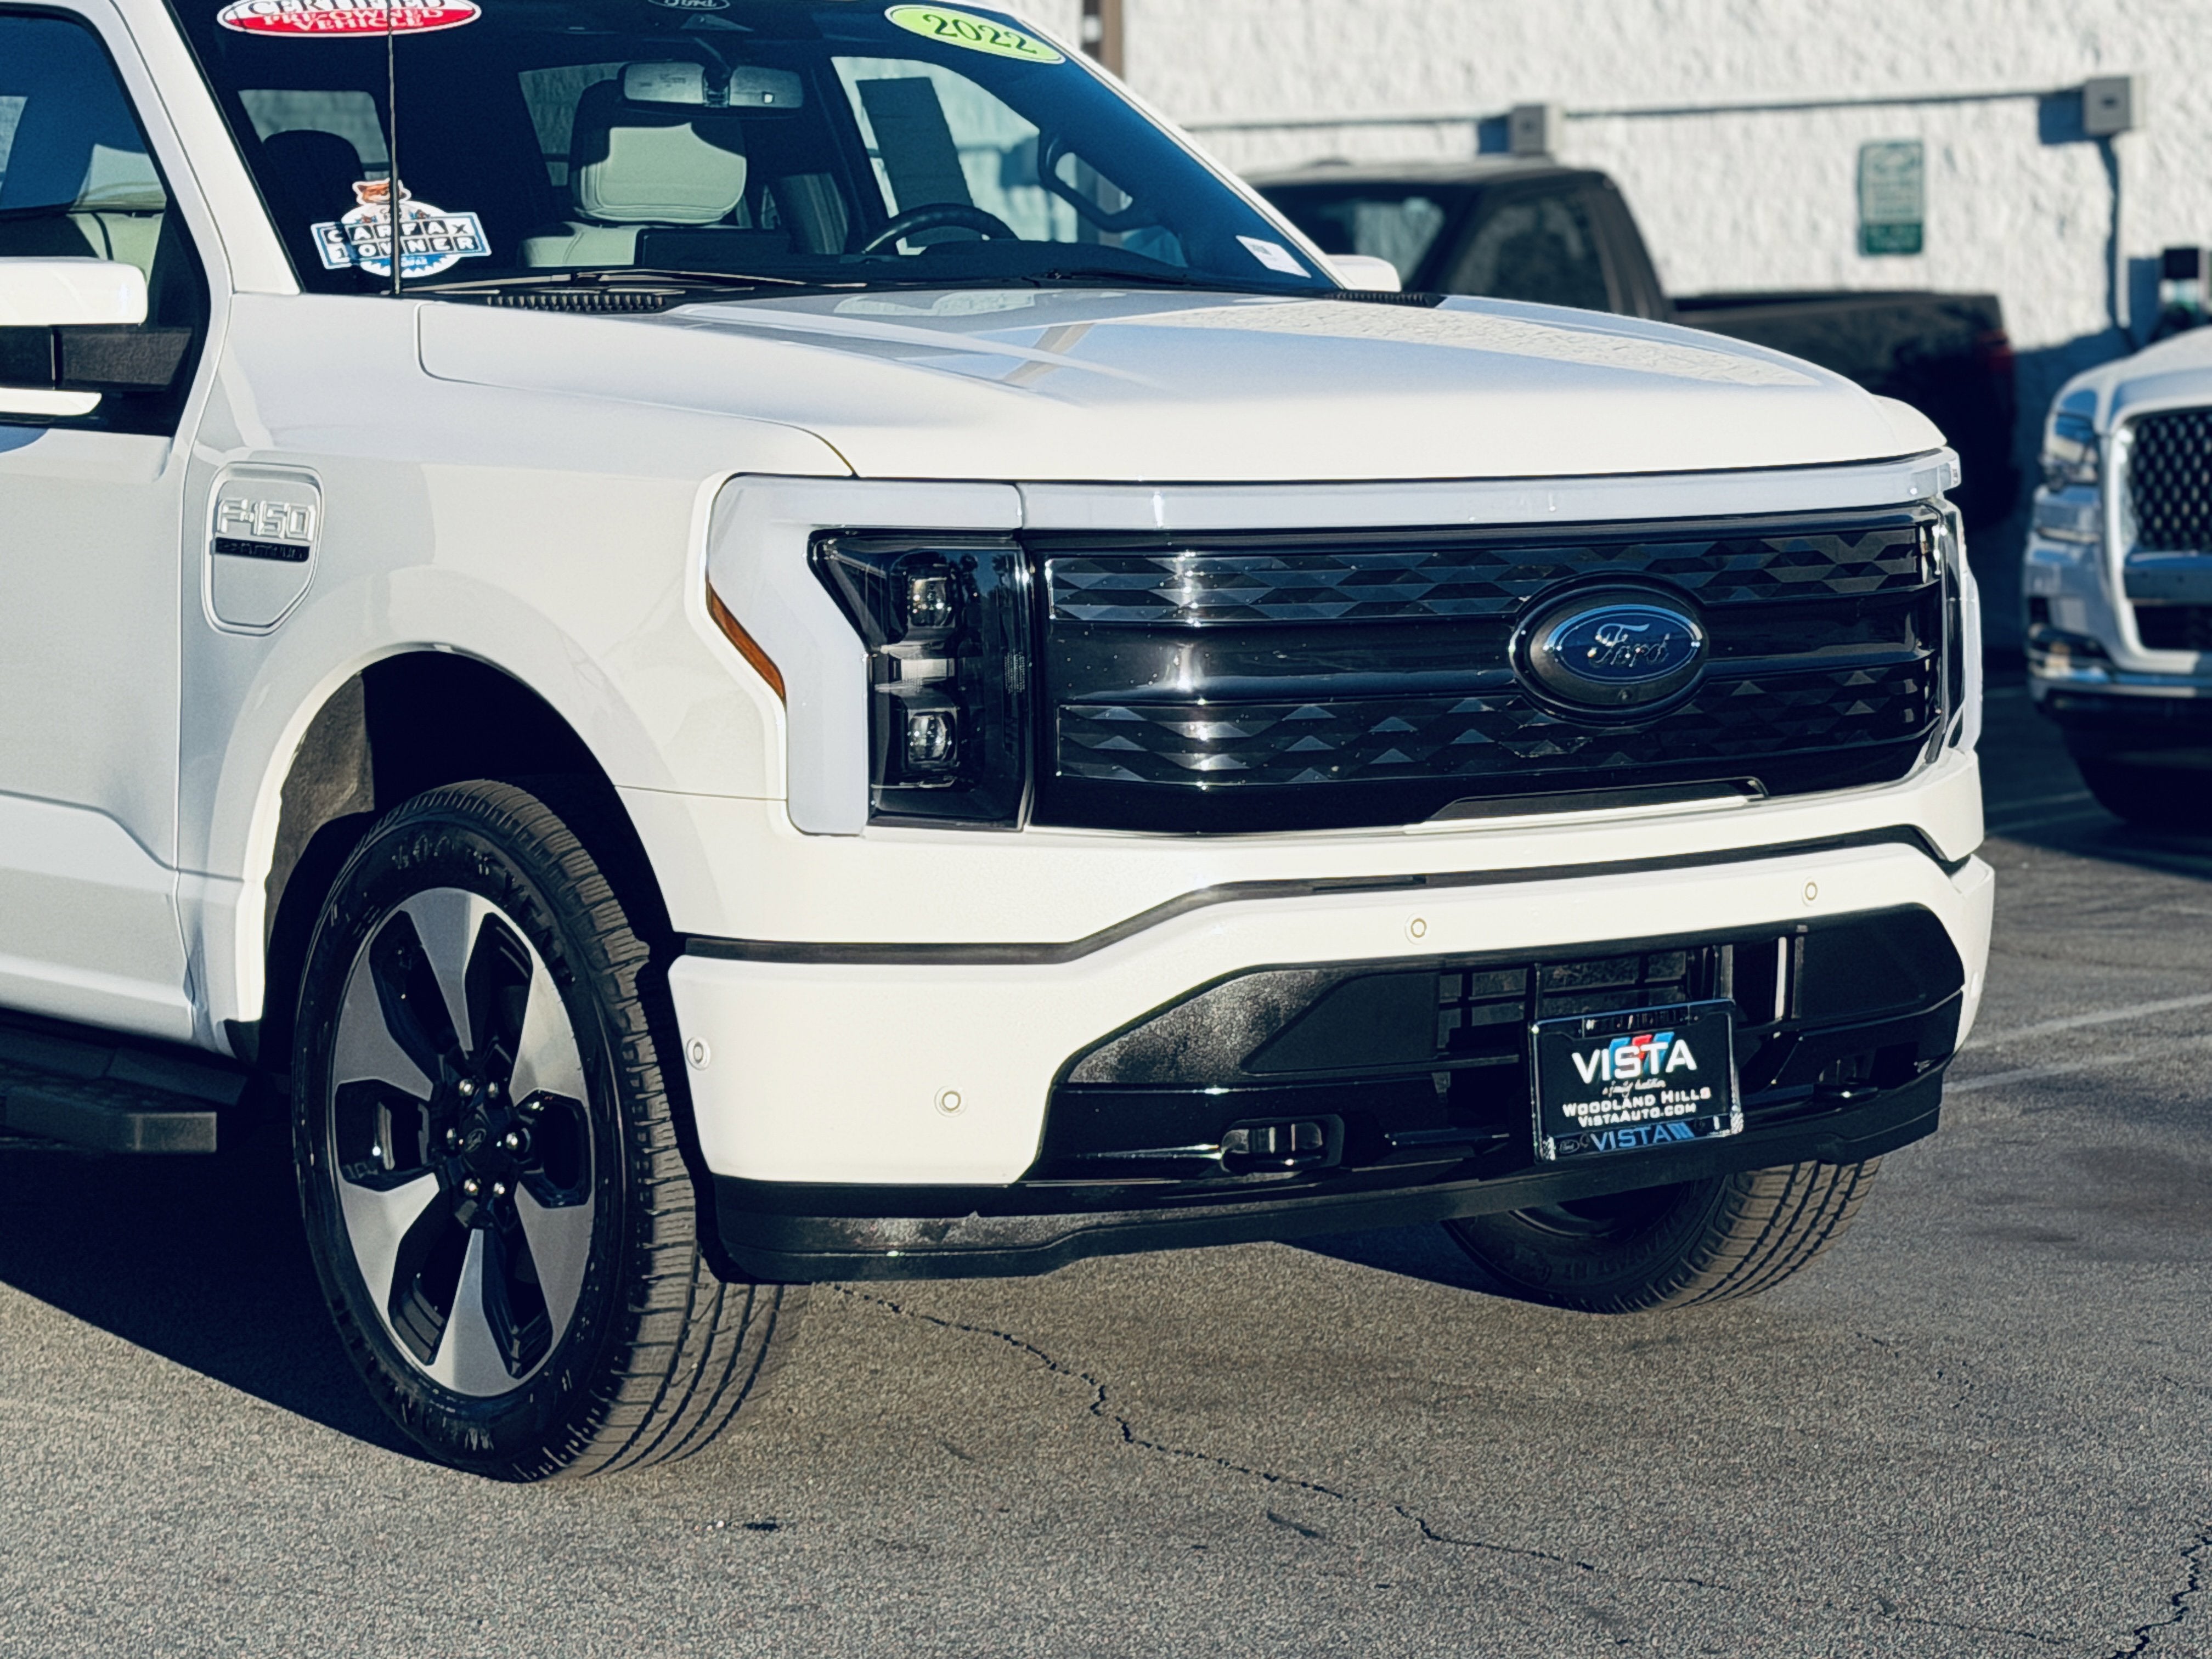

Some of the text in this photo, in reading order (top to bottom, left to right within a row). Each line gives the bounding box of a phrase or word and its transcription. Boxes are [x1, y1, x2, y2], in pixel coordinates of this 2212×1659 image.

[248, 0, 446, 15] CERTIFED
[922, 14, 1037, 54] 2022
[328, 220, 466, 242] CARFAX
[217, 497, 317, 541] F-150
[1587, 623, 1670, 668] Ford
[1572, 1039, 1697, 1084] VISTA
[1562, 1086, 1712, 1117] WOODLAND HILLS
[1590, 1126, 1672, 1152] VISTA
